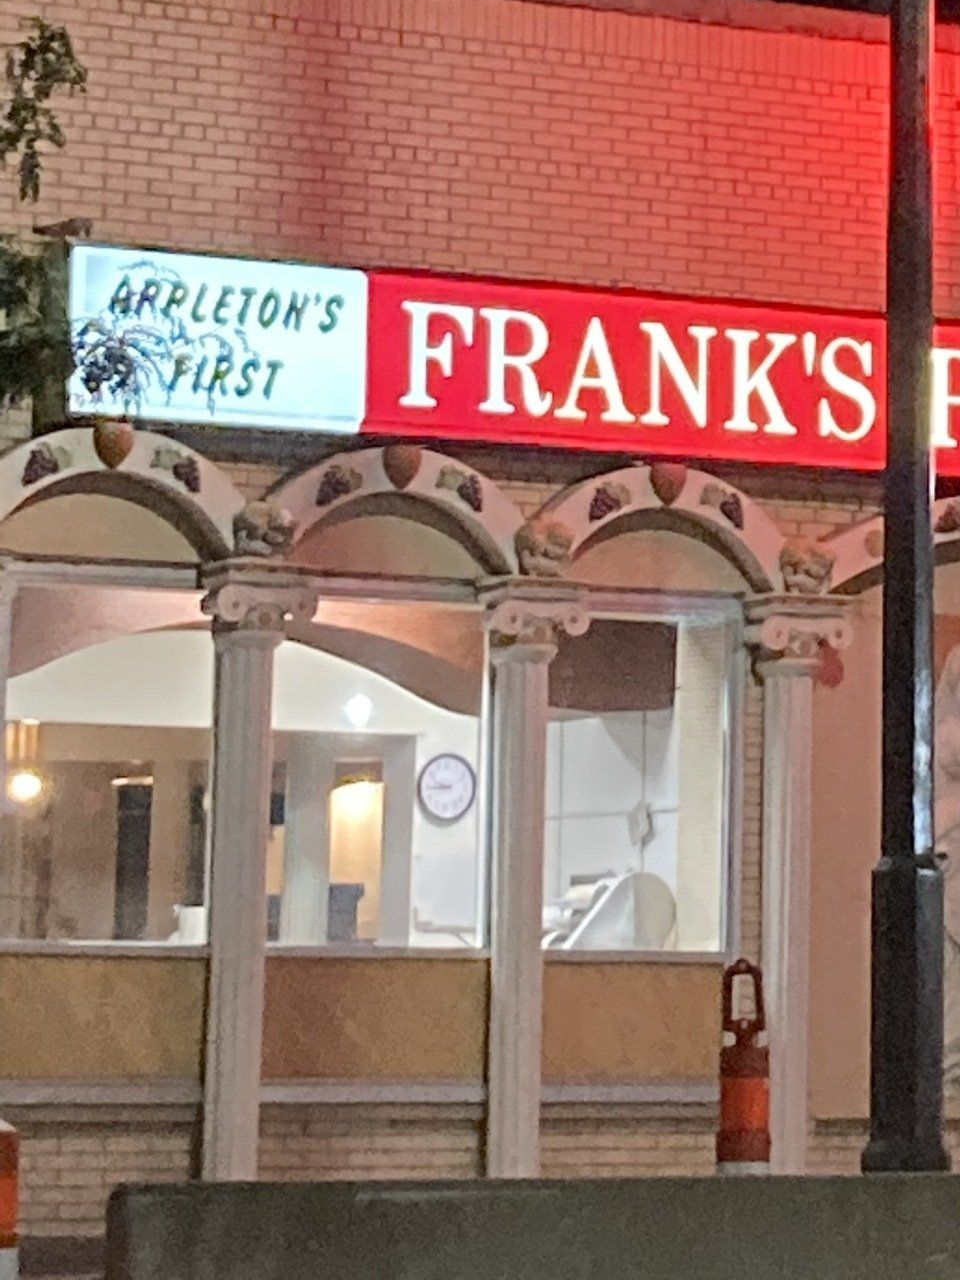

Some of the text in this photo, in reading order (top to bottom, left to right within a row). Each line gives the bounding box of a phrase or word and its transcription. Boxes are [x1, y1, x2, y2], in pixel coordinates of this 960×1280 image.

[110, 274, 345, 334] APPLETON'S
[166, 353, 284, 400] FIRST
[399, 299, 877, 441] FRANK'S
